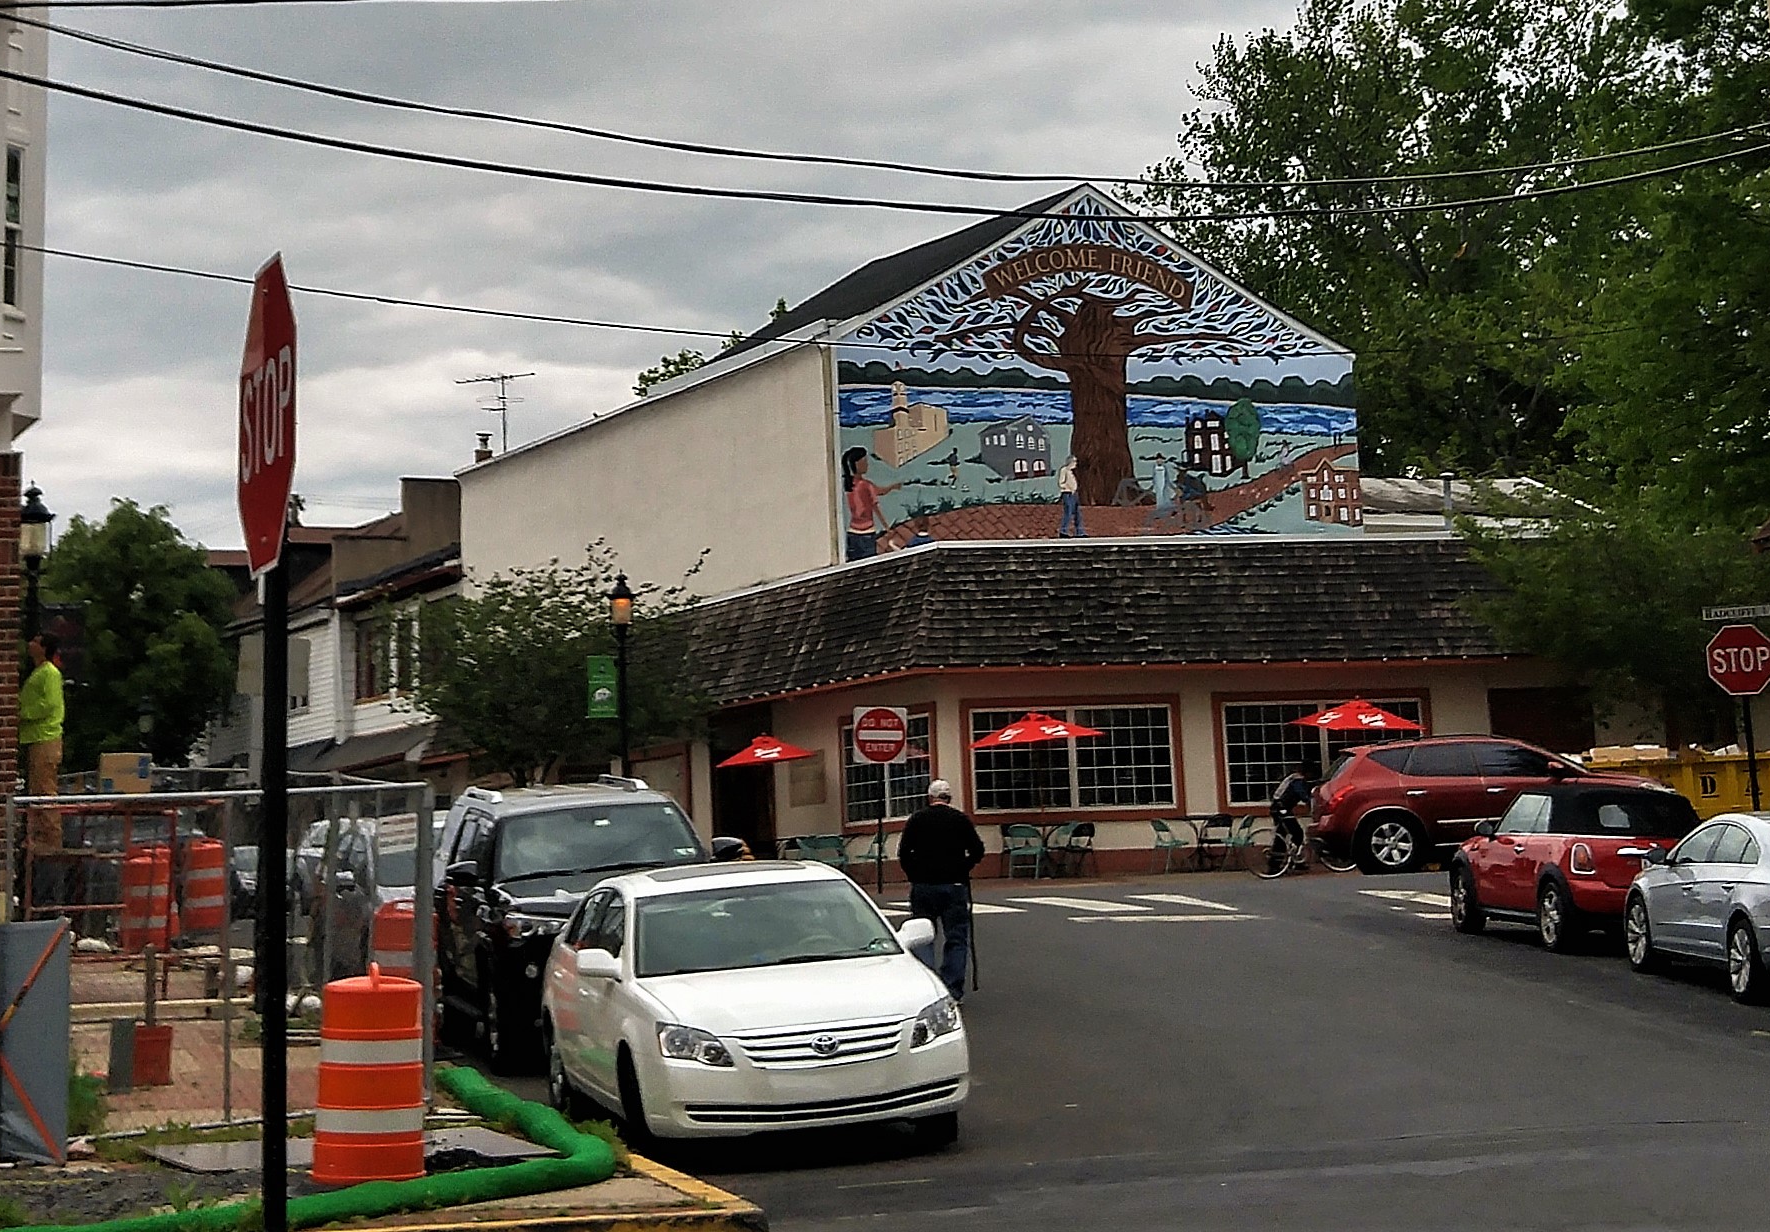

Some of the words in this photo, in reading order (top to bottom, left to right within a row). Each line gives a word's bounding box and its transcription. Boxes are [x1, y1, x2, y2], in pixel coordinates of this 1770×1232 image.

[994, 248, 1102, 289] WELCOME,
[1110, 253, 1186, 299] FRIEND
[241, 344, 292, 484] STOP
[1712, 646, 1770, 674] STOP
[861, 718, 875, 727] DO
[880, 718, 899, 727] NOT
[865, 742, 896, 753] ENTER
